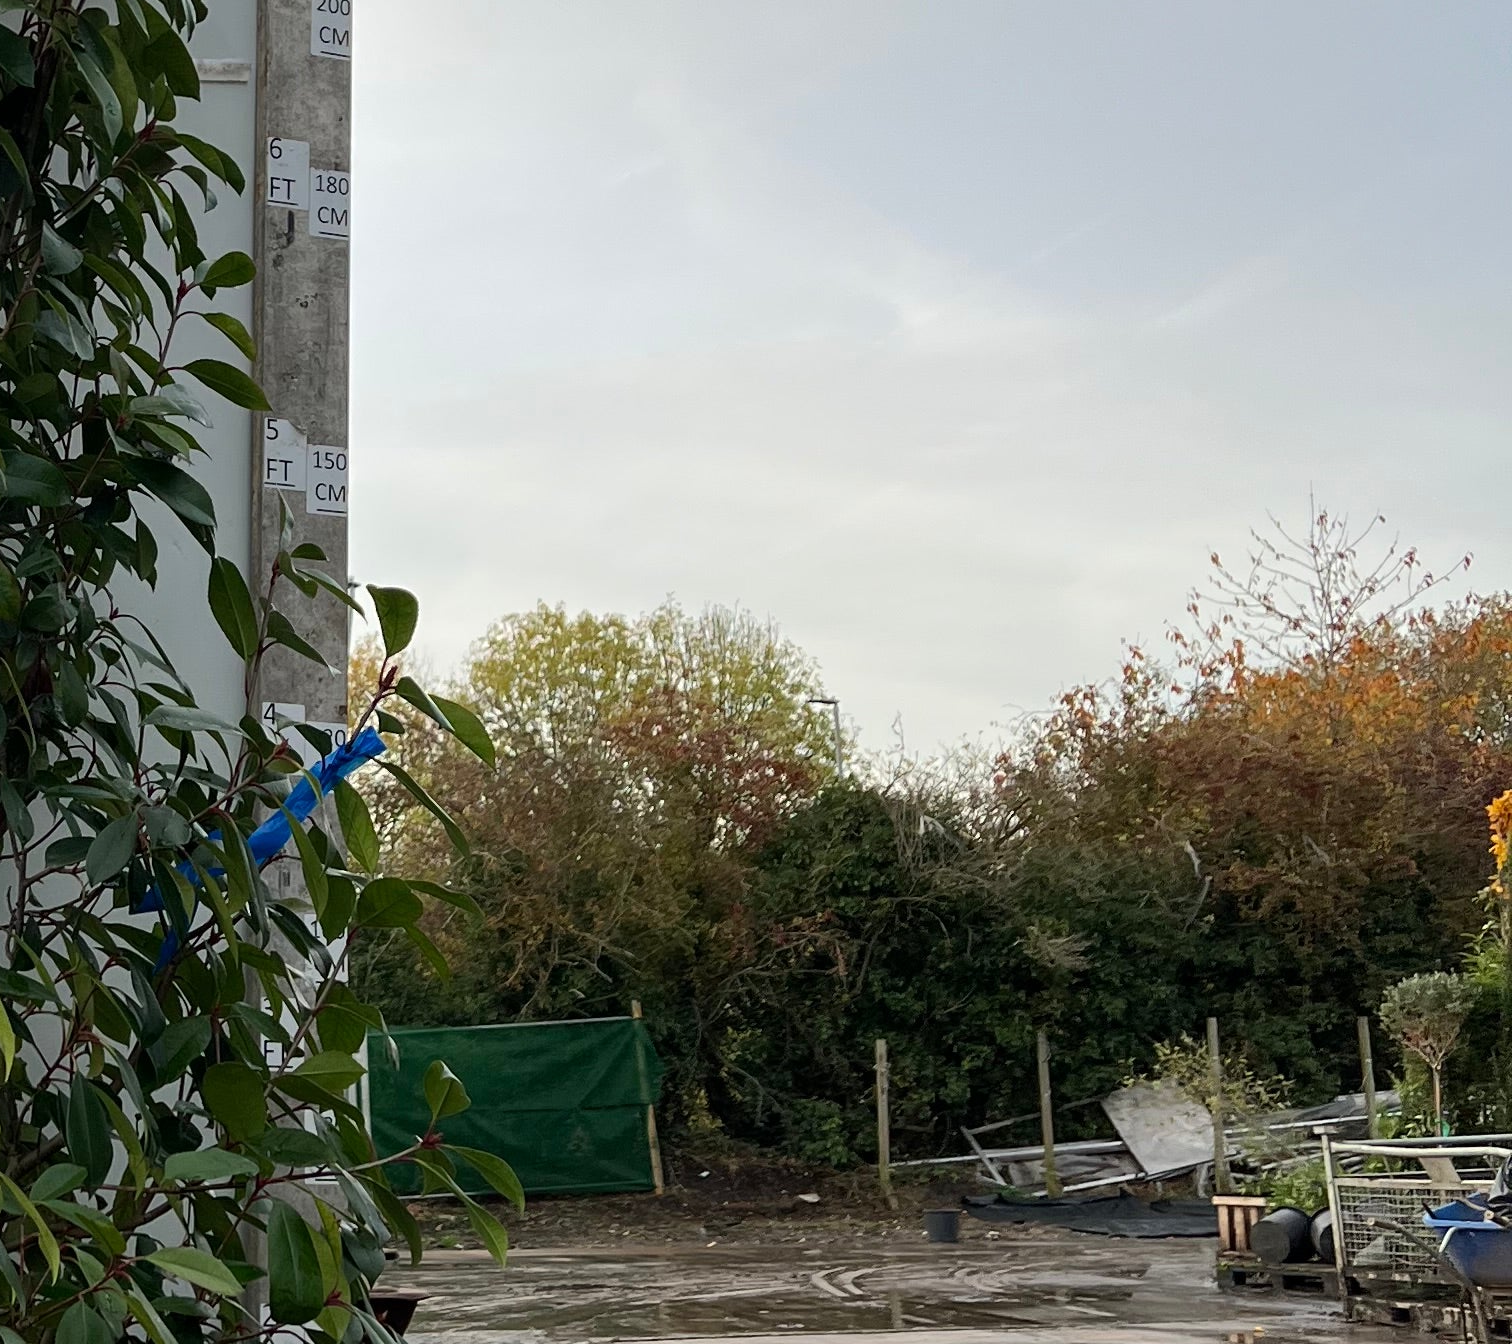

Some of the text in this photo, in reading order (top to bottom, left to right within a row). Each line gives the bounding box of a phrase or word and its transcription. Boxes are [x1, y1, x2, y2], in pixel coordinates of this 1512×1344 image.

[319, 26, 349, 47] CM
[269, 137, 283, 159] 6
[270, 176, 296, 200] FT
[315, 174, 349, 196] 180
[317, 206, 348, 227] CM
[266, 418, 279, 440] 5
[266, 458, 293, 482] FT
[313, 451, 347, 471] 150
[315, 483, 346, 502] CM
[263, 703, 276, 725] 4
